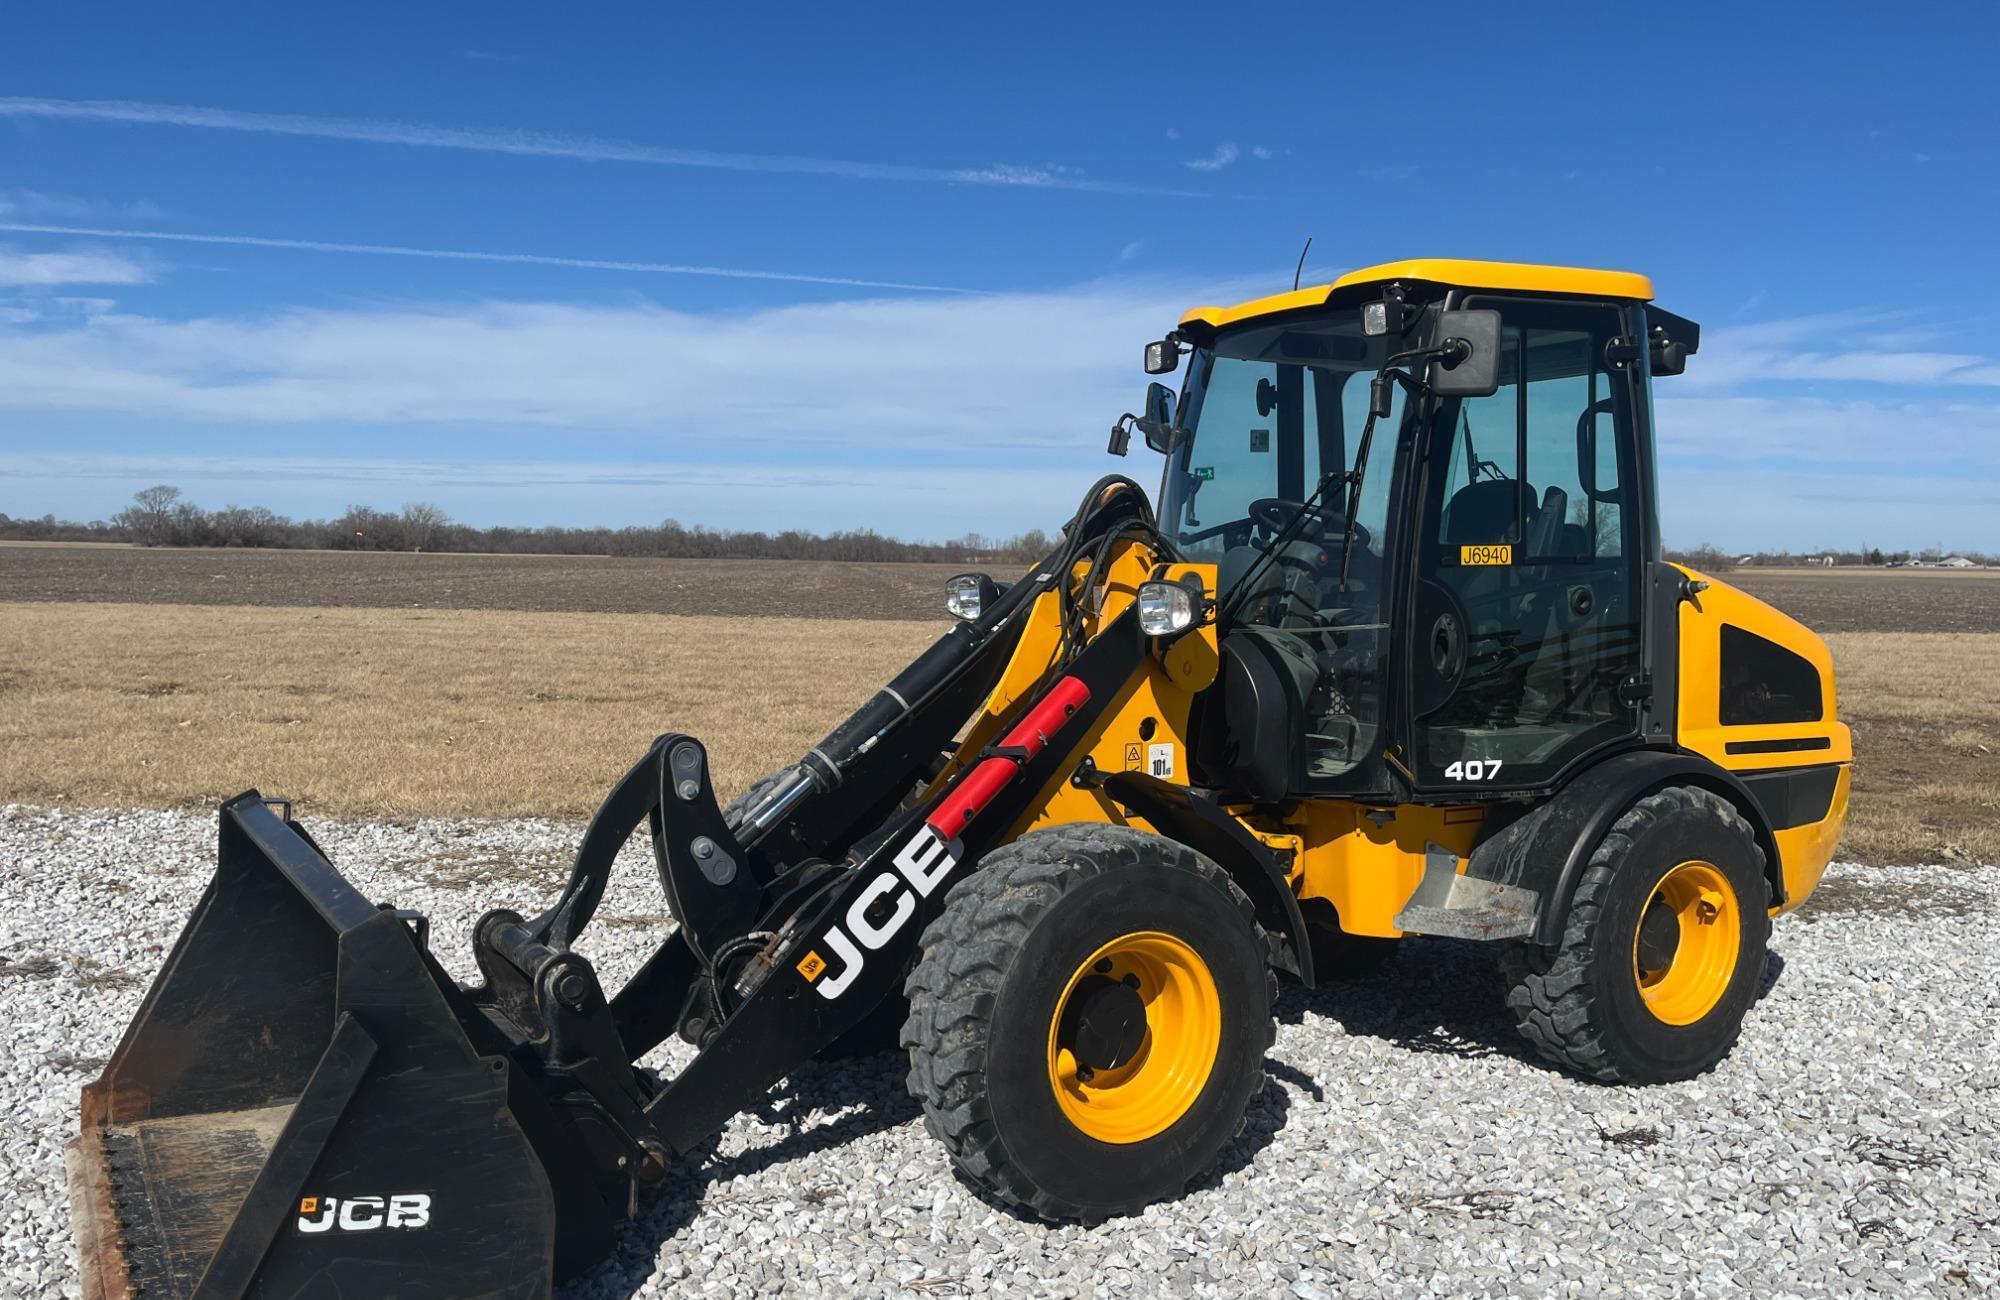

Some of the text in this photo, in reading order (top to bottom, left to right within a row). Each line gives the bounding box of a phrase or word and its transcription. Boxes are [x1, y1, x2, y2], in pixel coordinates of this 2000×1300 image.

[1463, 546, 1509, 564] J6940
[1152, 758, 1166, 776] 101
[1444, 759, 1503, 781] 407
[298, 1194, 431, 1233] JCB
